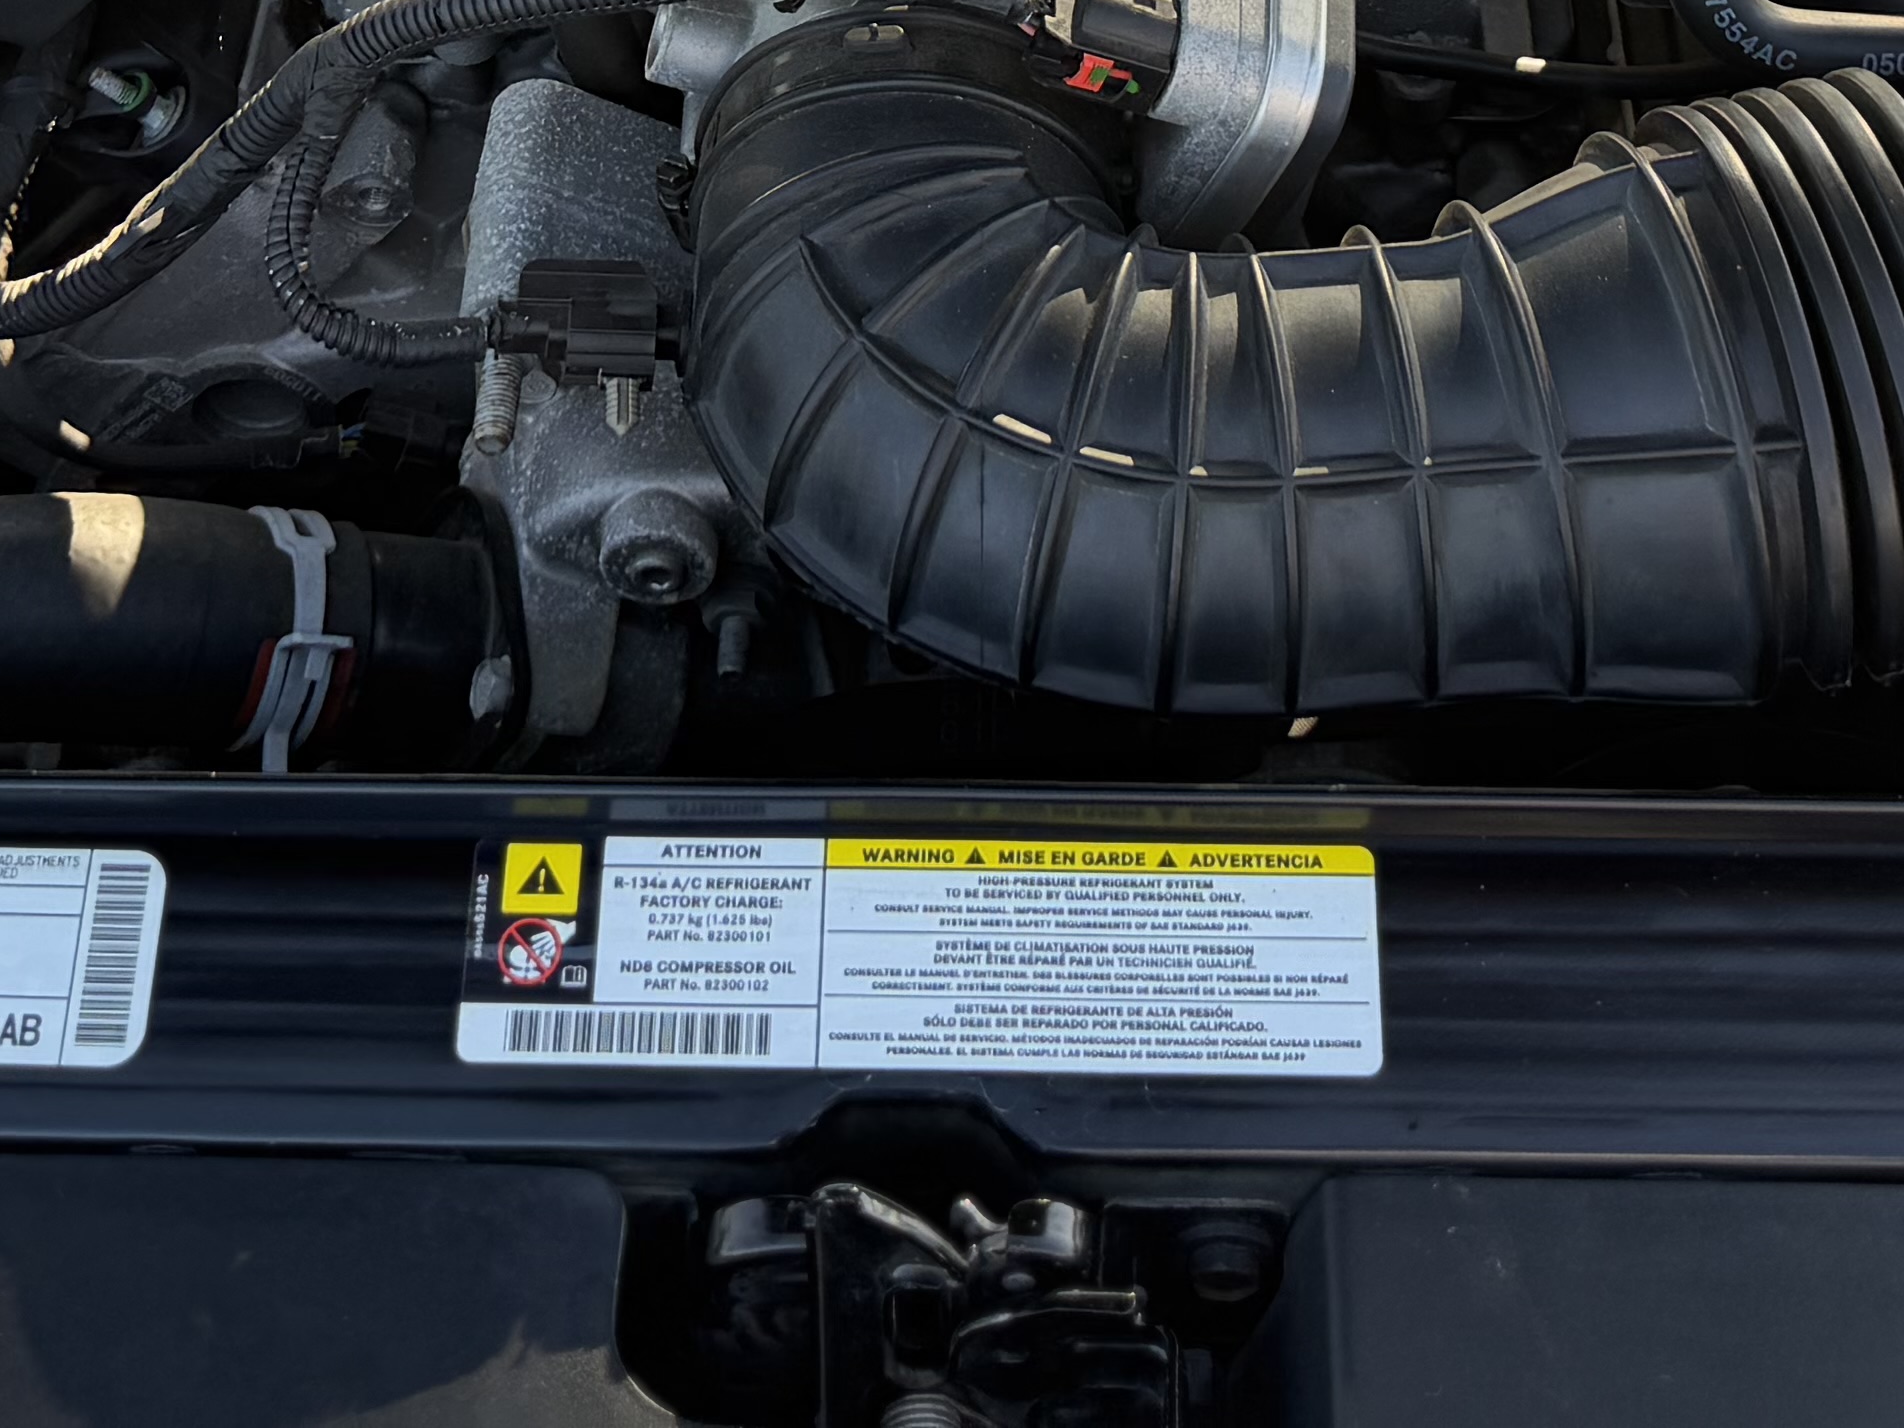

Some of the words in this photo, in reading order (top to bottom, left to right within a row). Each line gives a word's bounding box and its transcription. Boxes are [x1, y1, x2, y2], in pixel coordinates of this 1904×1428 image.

[661, 844, 762, 859] ATTENTION
[862, 848, 955, 864] WARNING
[998, 849, 1045, 865] MISE
[1051, 850, 1076, 865] EN
[1082, 851, 1146, 866] GARDE
[1189, 852, 1324, 869] ADVERTENCIA
[614, 875, 668, 890] R-134a
[671, 876, 702, 892] A/C
[705, 877, 812, 891] REFRIGERANT
[640, 895, 711, 908] FACTORY
[715, 896, 784, 909] CHARGE:
[945, 887, 961, 899] TO
[964, 888, 980, 899] BE
[983, 888, 1043, 900] SERVICED
[1045, 890, 1061, 901] BY
[1064, 890, 1130, 902] QUALIFIED
[648, 913, 684, 925] 0.737
[688, 913, 703, 928] kg
[647, 929, 679, 942] PART
[707, 930, 771, 943] 82300101
[657, 960, 765, 975] COMPRESSOR
[769, 961, 797, 975] OIL
[644, 978, 676, 991] PART
[705, 979, 769, 993] 82300102
